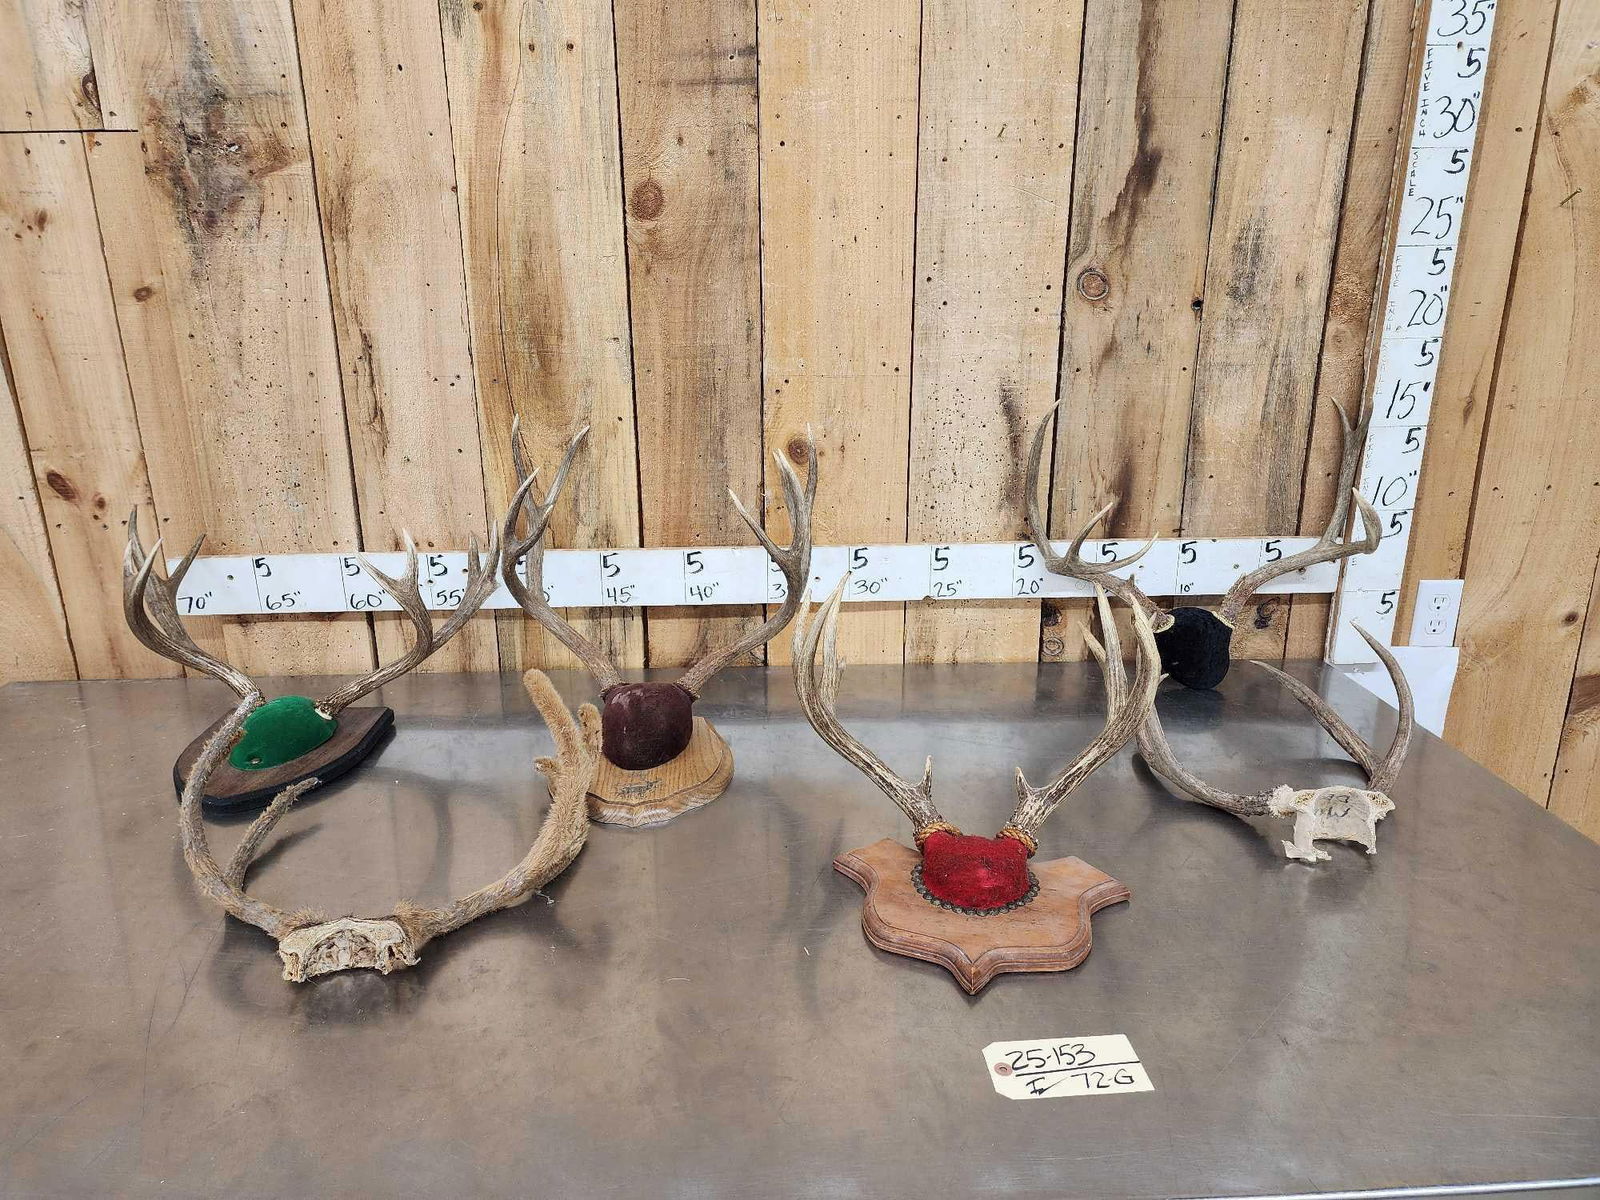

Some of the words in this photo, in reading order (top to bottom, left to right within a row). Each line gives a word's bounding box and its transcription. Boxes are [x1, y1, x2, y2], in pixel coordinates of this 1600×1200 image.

[1423, 48, 1433, 92] FIVE
[1457, 47, 1486, 78] 5
[1419, 99, 1429, 137] INCH
[1433, 91, 1480, 138] 30"
[1408, 152, 1419, 196] SCALE
[1444, 148, 1469, 174] 5
[1411, 195, 1464, 239] 25"
[1427, 247, 1452, 276] 5
[1407, 285, 1447, 328] 20"
[1414, 338, 1438, 367] 5
[1386, 379, 1431, 420] 15"
[1402, 427, 1421, 454] 5
[1371, 470, 1417, 506] 10"
[1380, 511, 1408, 539] 5
[254, 557, 272, 577] 5
[344, 556, 361, 576] 5
[430, 554, 448, 576] 5
[602, 553, 620, 578] 5
[686, 551, 704, 574] 5
[851, 547, 869, 569] 5
[931, 546, 951, 571] 5
[1017, 543, 1035, 568] 5
[1102, 542, 1118, 562] 5
[1180, 541, 1197, 564] 5
[1265, 540, 1282, 562] 5
[178, 591, 212, 613] 70"
[266, 591, 301, 611] 65"
[606, 584, 635, 605] 45"
[689, 581, 720, 601] 40"
[853, 577, 888, 595] 30"
[933, 579, 962, 598] 25"
[1180, 582, 1194, 594] 10"
[1376, 590, 1396, 615] 5
[1005, 1043, 1096, 1071] 25-153
[1070, 1068, 1134, 1089] 72-G
